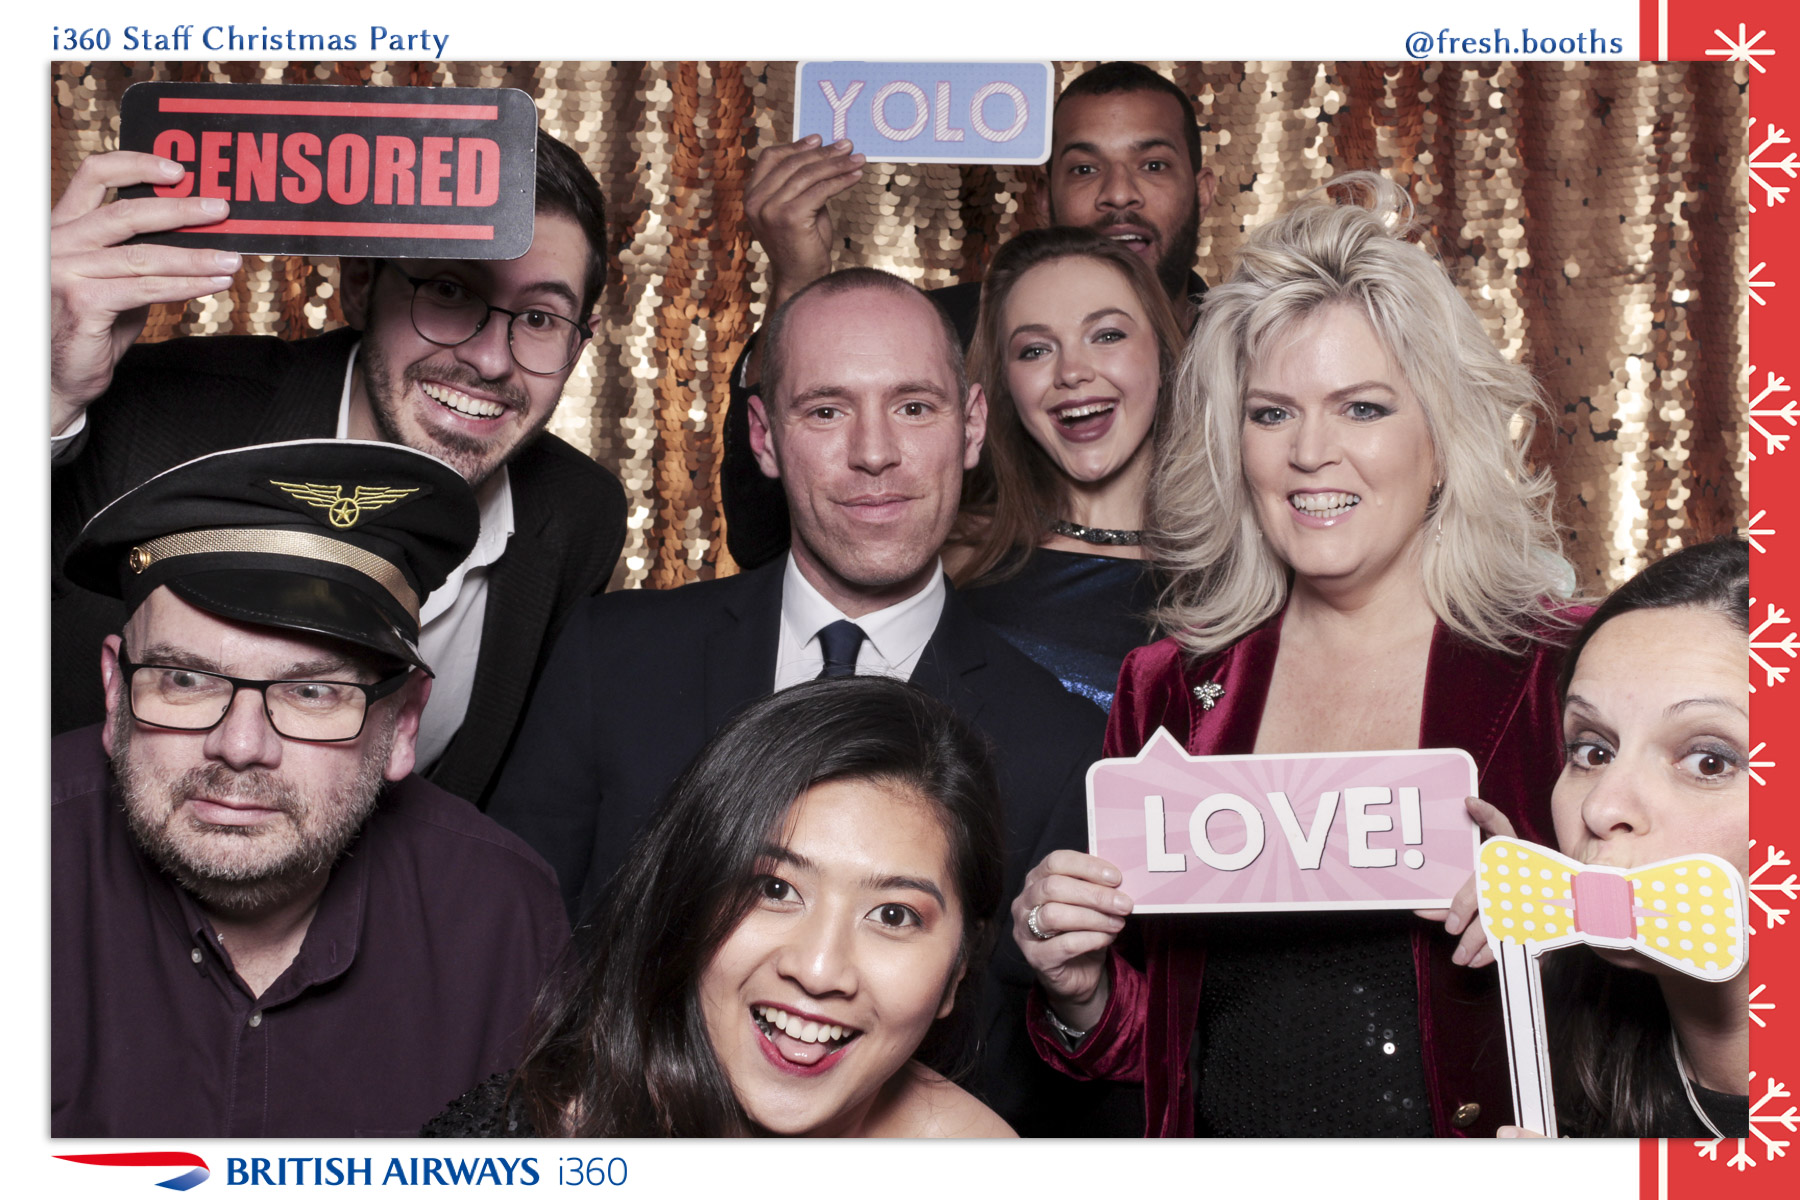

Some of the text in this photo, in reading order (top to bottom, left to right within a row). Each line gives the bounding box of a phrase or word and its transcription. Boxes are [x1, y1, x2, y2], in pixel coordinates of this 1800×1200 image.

[817, 79, 1031, 143] YOLO
[153, 128, 500, 208] CENSORED
[1143, 785, 1426, 873] LOVE!
